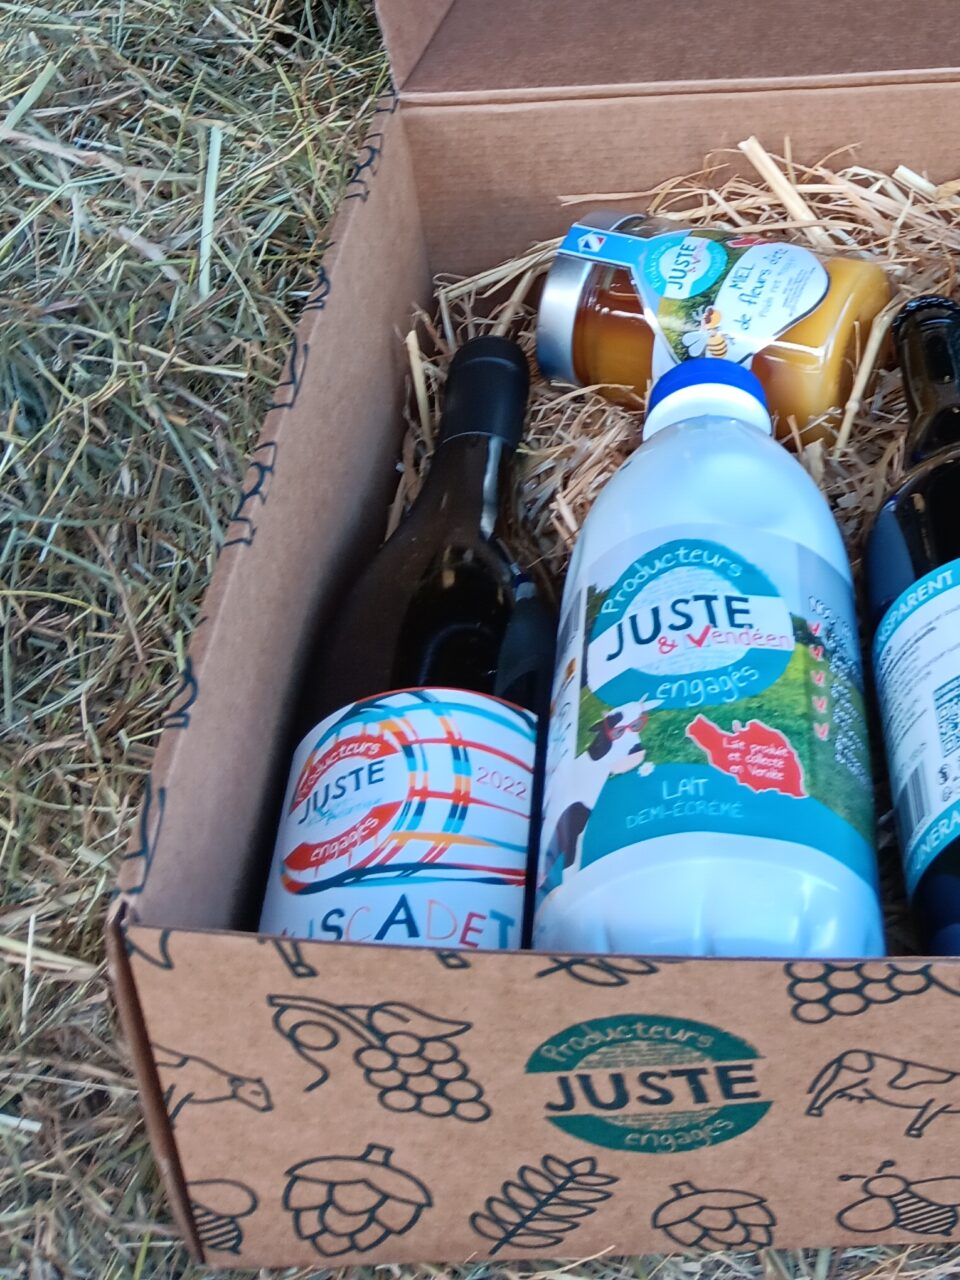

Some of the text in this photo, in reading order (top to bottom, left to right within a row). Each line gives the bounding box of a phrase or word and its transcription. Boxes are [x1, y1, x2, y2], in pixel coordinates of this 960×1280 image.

[668, 243, 697, 291] JUSTE
[601, 545, 743, 615] Producteurs
[606, 594, 754, 662] JUSTE
[657, 623, 789, 654] & Vendéen
[655, 665, 760, 707] engagés
[298, 759, 385, 825] JUSTE
[476, 766, 529, 801] 2022
[662, 776, 709, 800] LAIT
[281, 893, 517, 950] SCADET
[540, 1021, 715, 1063] Producteurs
[545, 1064, 761, 1112] JUSTE
